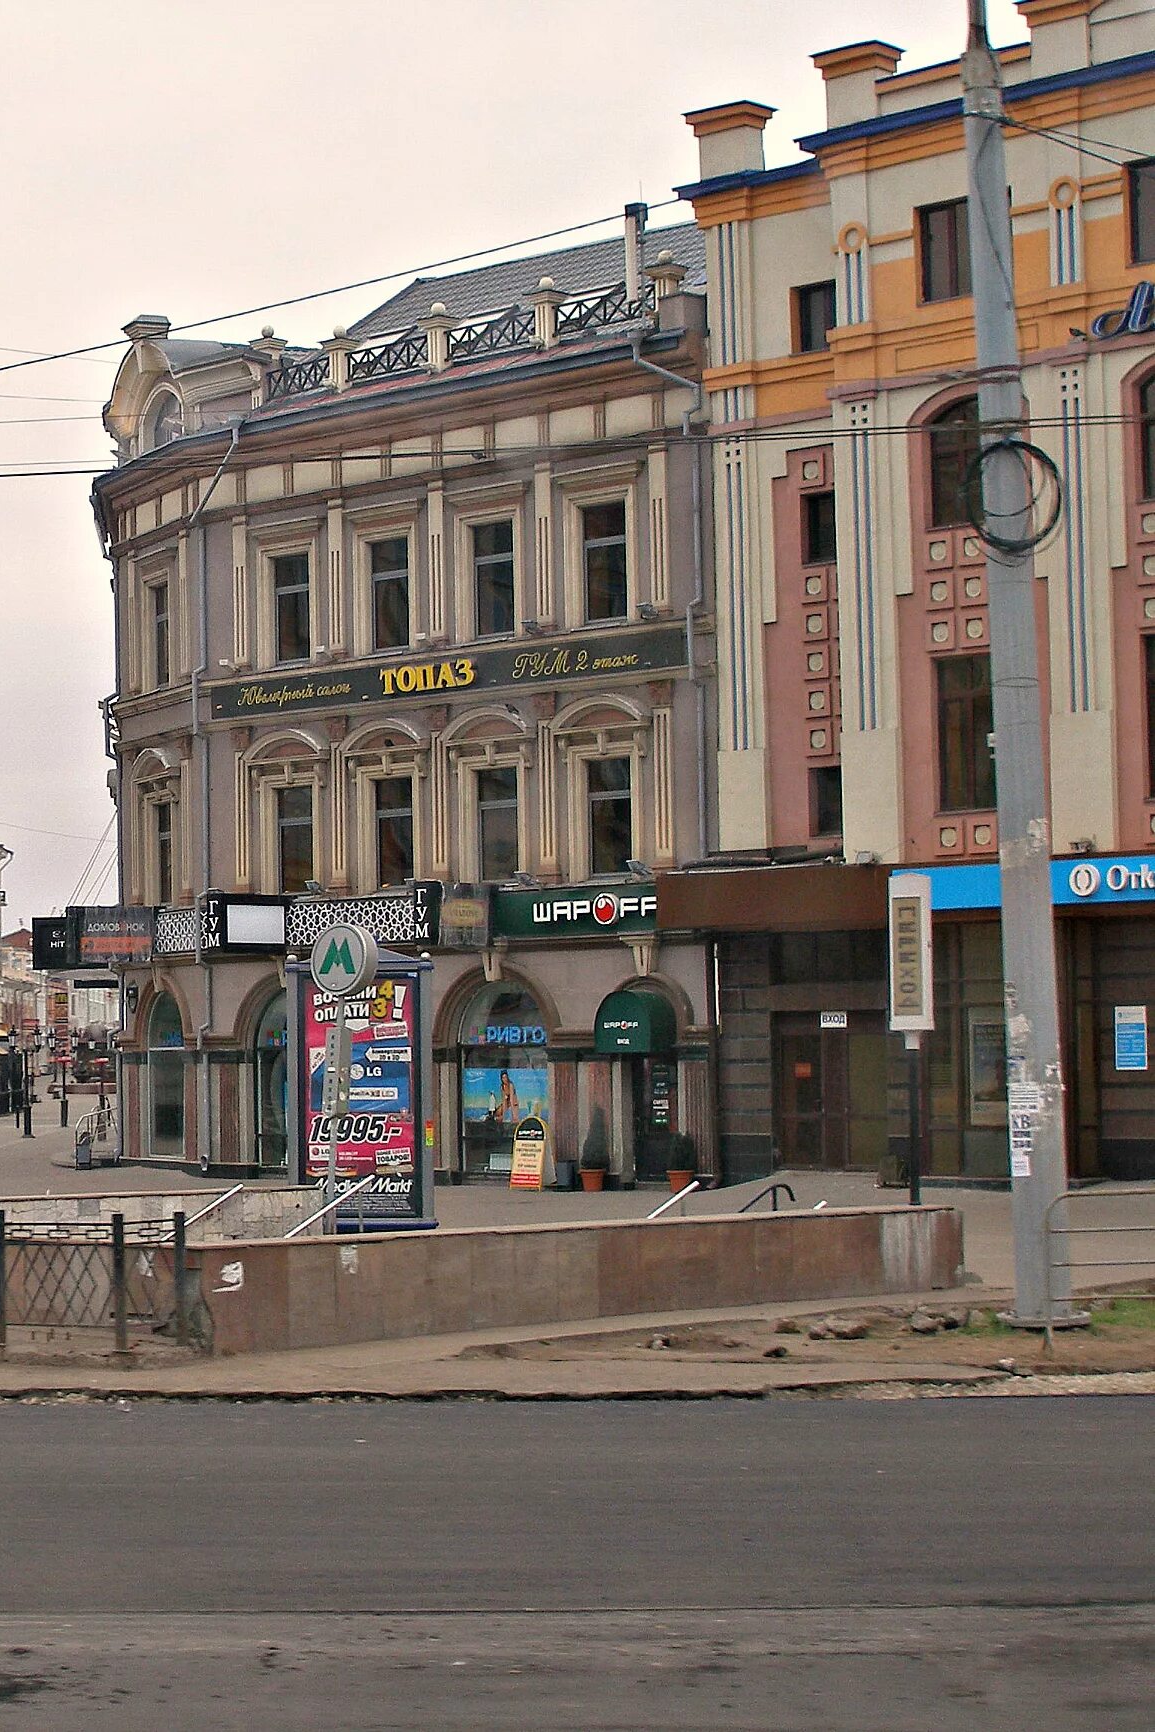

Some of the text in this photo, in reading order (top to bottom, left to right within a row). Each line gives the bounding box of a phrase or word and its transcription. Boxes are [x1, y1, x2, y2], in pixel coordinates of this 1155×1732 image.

[512, 650, 639, 679] ГУМ 2 этаж
[379, 659, 475, 695] ТОПАЗ
[316, 684, 351, 697] салон
[208, 900, 221, 948] ГУМ
[415, 888, 429, 938] ГУМ
[313, 985, 377, 1006] ВОМИ
[378, 980, 394, 999] 4
[372, 998, 387, 1017] 3
[822, 1014, 845, 1024] ВХОД
[366, 1066, 382, 1077] LG
[369, 1177, 413, 1193] Markt
